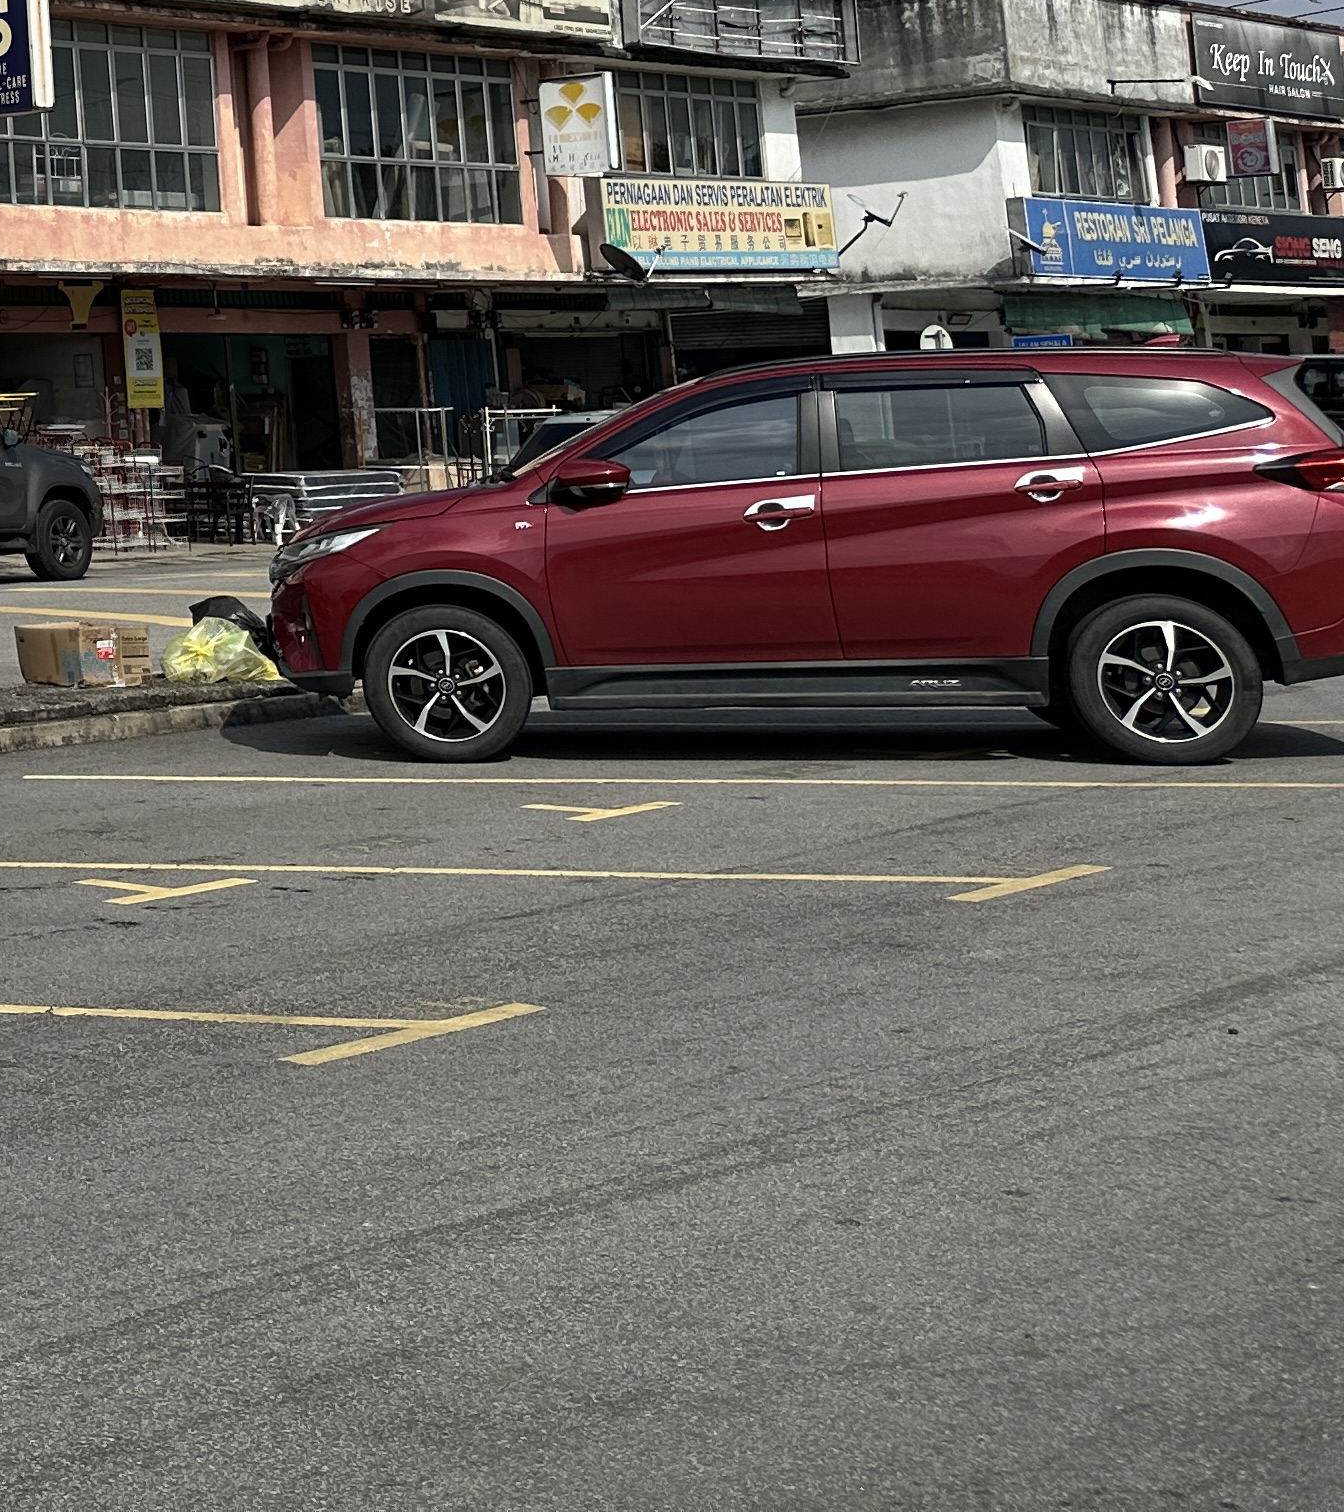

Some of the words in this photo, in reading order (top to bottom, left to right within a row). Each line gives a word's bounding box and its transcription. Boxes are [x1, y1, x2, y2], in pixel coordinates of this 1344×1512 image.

[1210, 44, 1250, 81] Keep
[1258, 51, 1275, 76] In
[1280, 52, 1322, 82] Touch
[606, 182, 671, 205] PERNIAGAAN
[673, 183, 693, 206] DAN
[695, 184, 728, 207] SERVIS
[730, 185, 782, 207] PERALATAN
[784, 187, 827, 208] ELEKTRIK
[630, 210, 694, 232] ELECTRONIC
[696, 210, 727, 232] SALES
[738, 211, 783, 233] SERVICES
[1073, 211, 1131, 243] RESTORAN
[1132, 215, 1151, 245] SRI
[1312, 237, 1342, 259] SENG
